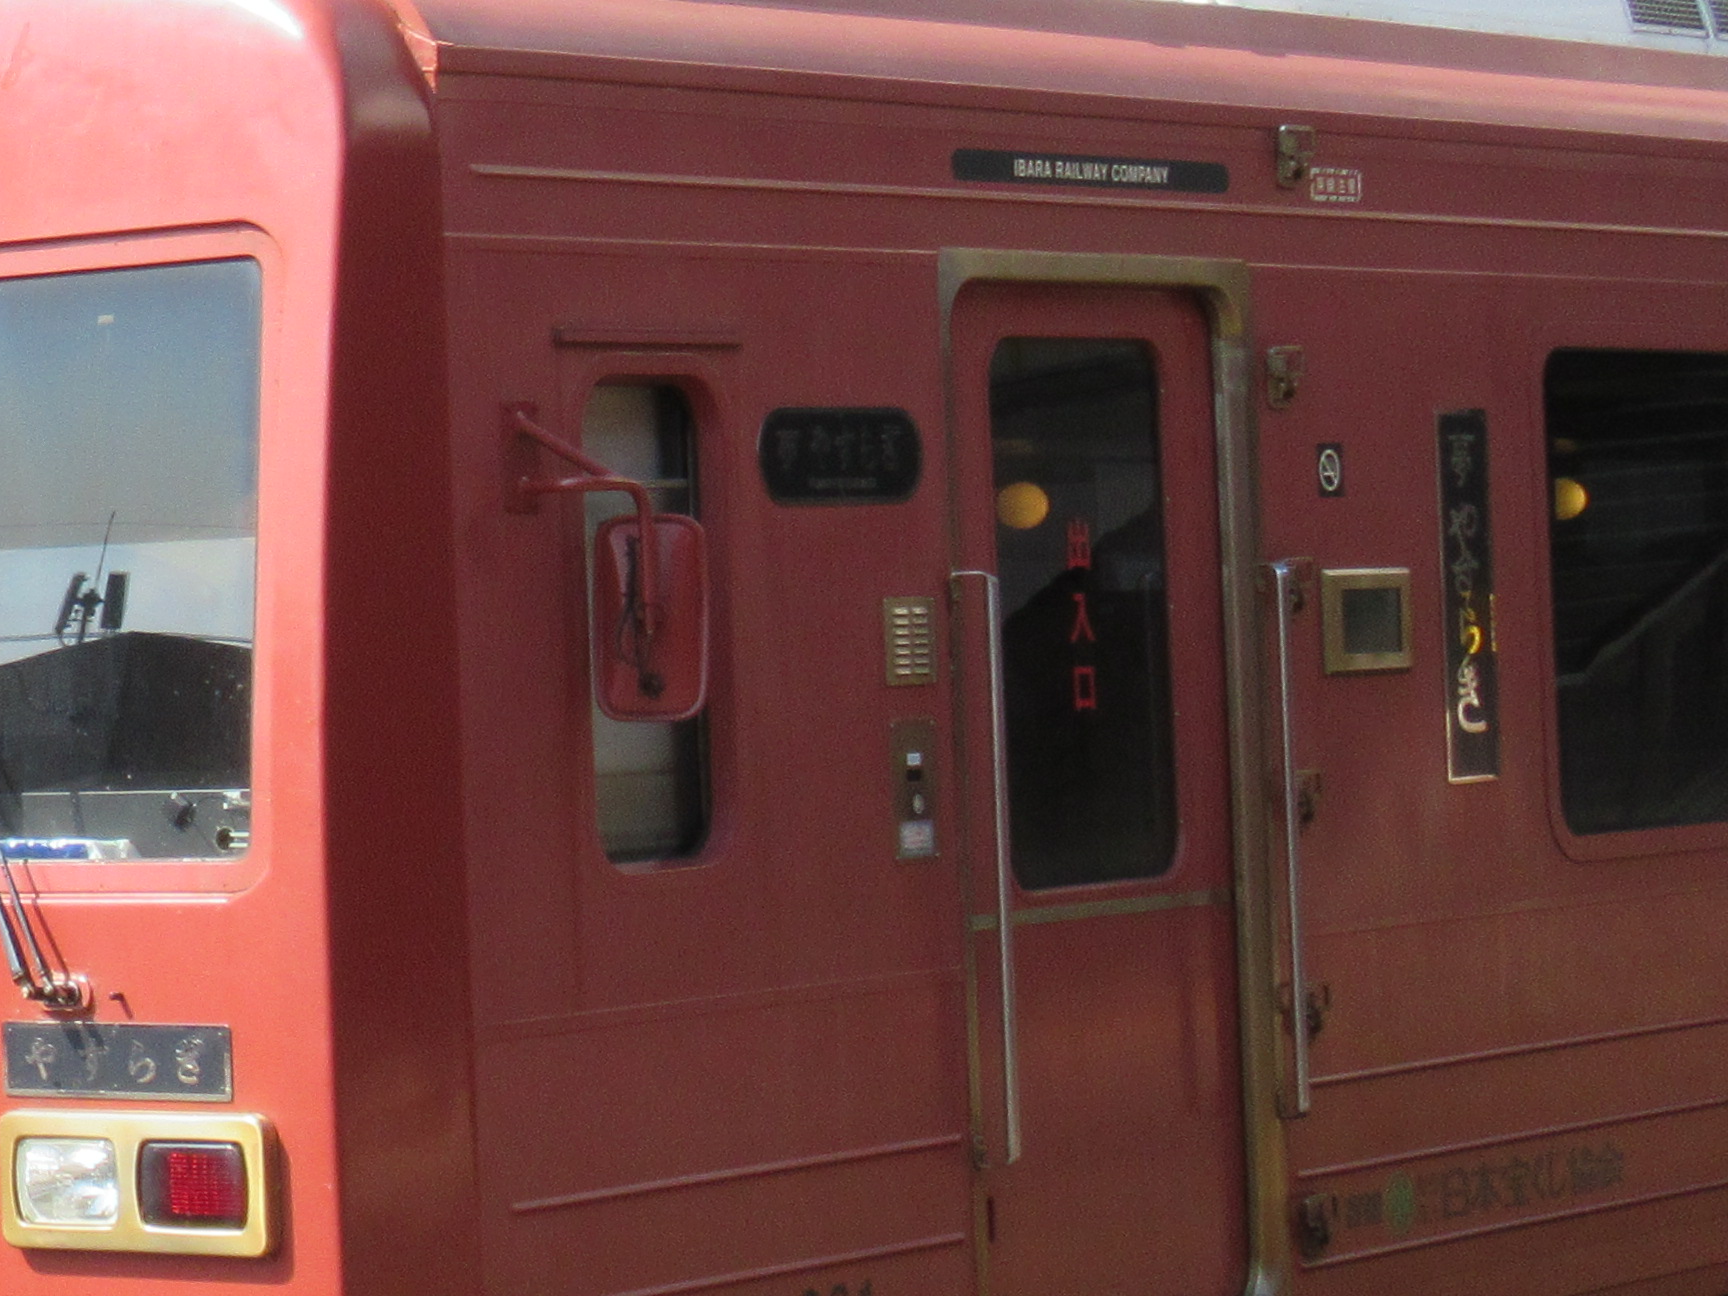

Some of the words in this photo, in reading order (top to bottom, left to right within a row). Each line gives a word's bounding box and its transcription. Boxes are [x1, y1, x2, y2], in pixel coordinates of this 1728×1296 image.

[1013, 158, 1052, 178] IBARA
[1055, 161, 1108, 181] RAILWAY
[1110, 164, 1169, 184] COMPANY
[1066, 518, 1098, 711] 出入口
